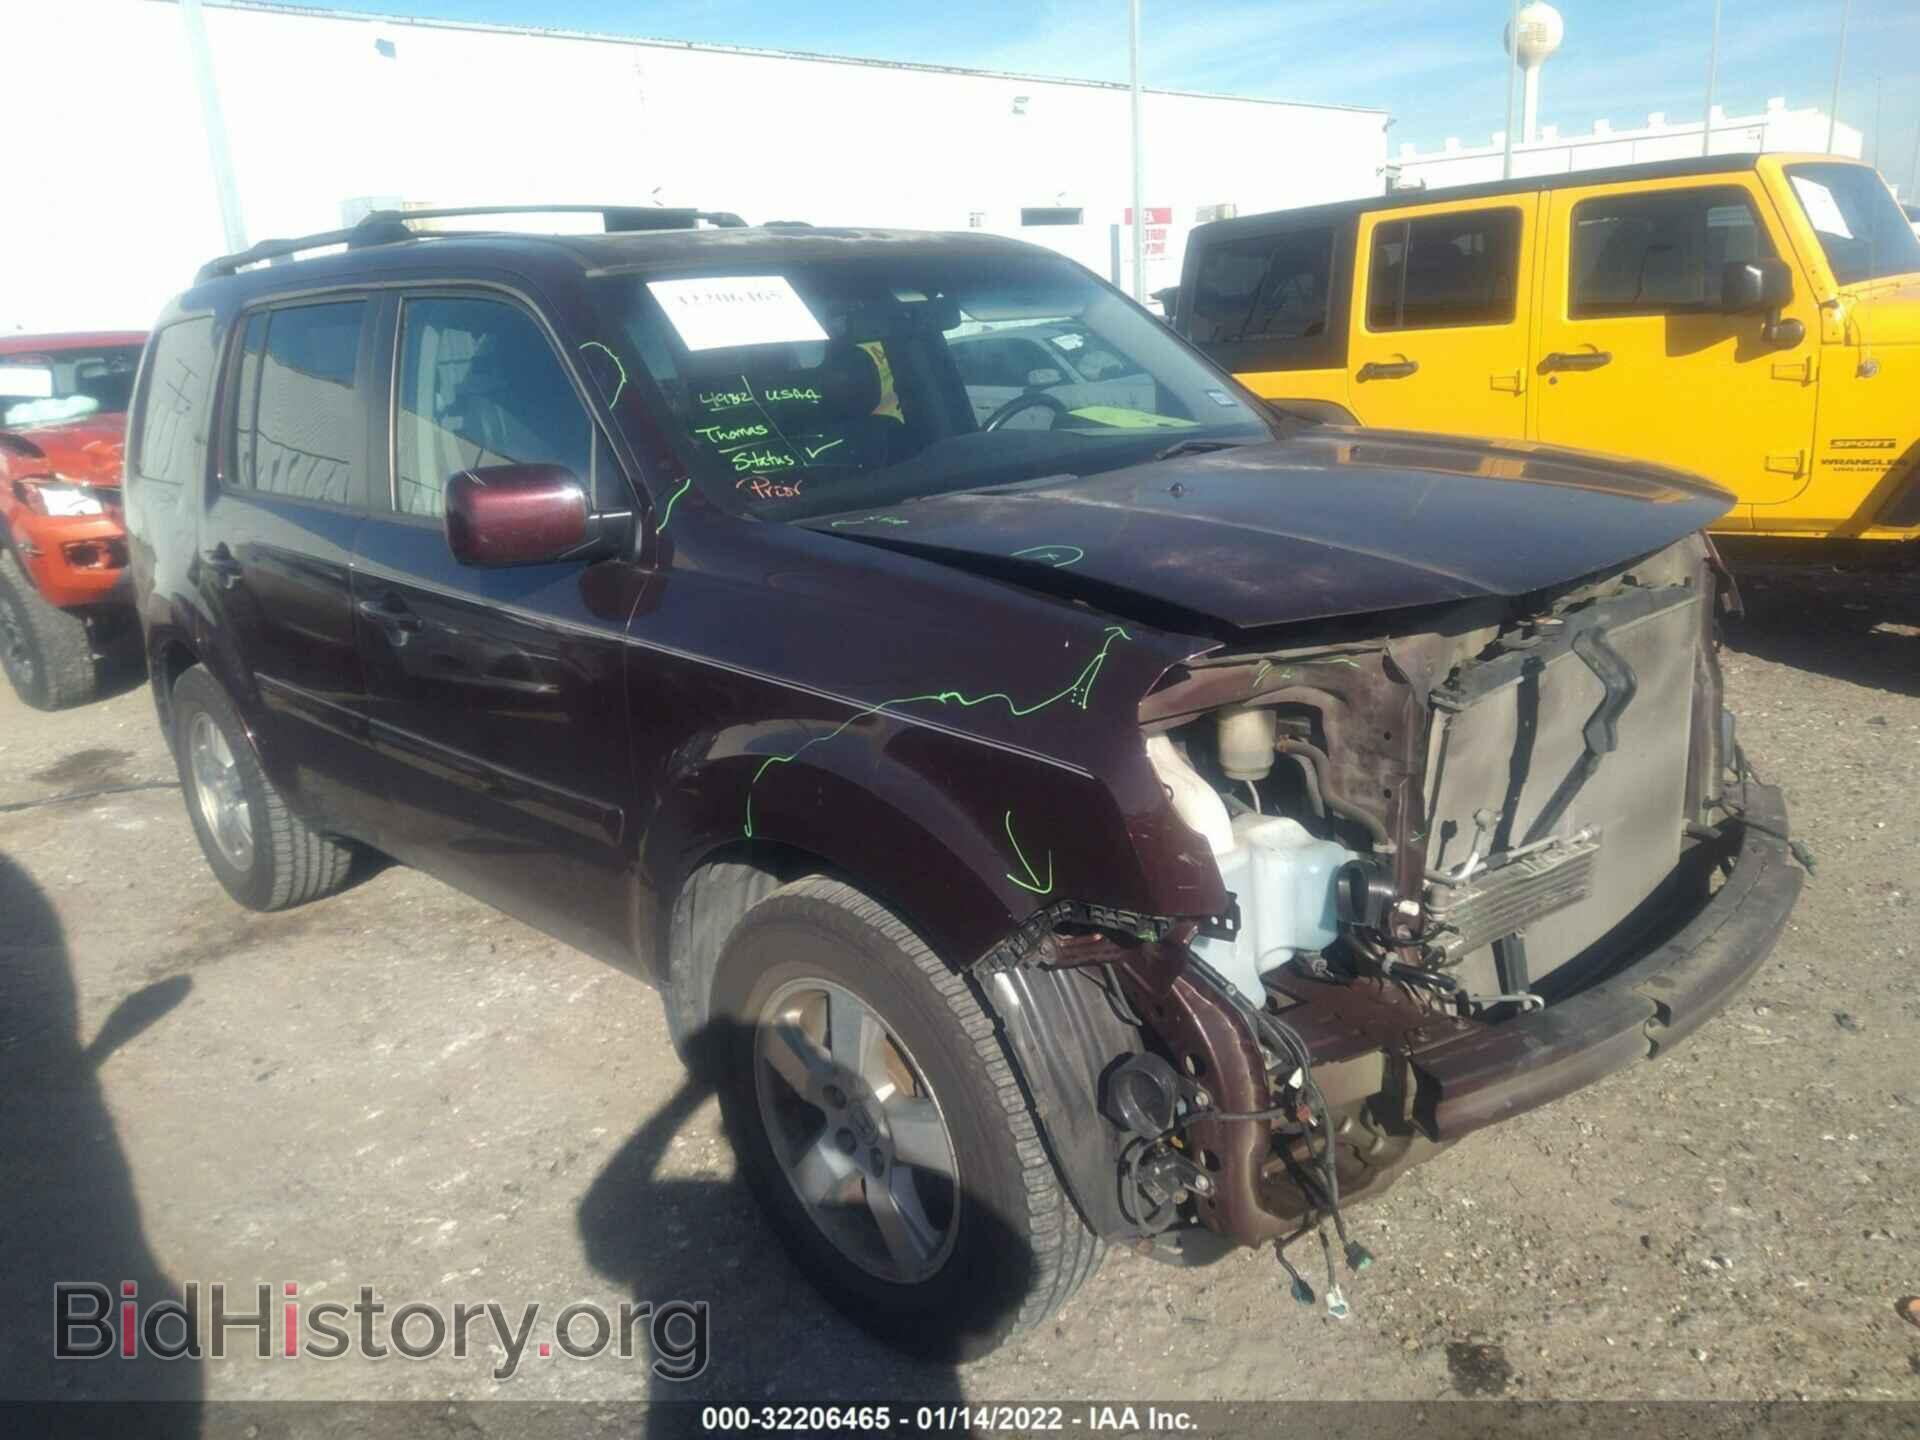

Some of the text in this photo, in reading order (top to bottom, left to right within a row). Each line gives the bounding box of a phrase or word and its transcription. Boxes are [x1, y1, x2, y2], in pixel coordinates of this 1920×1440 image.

[695, 425, 769, 444] Thomas
[1831, 439, 1896, 449] SPORT
[732, 450, 795, 471] Status
